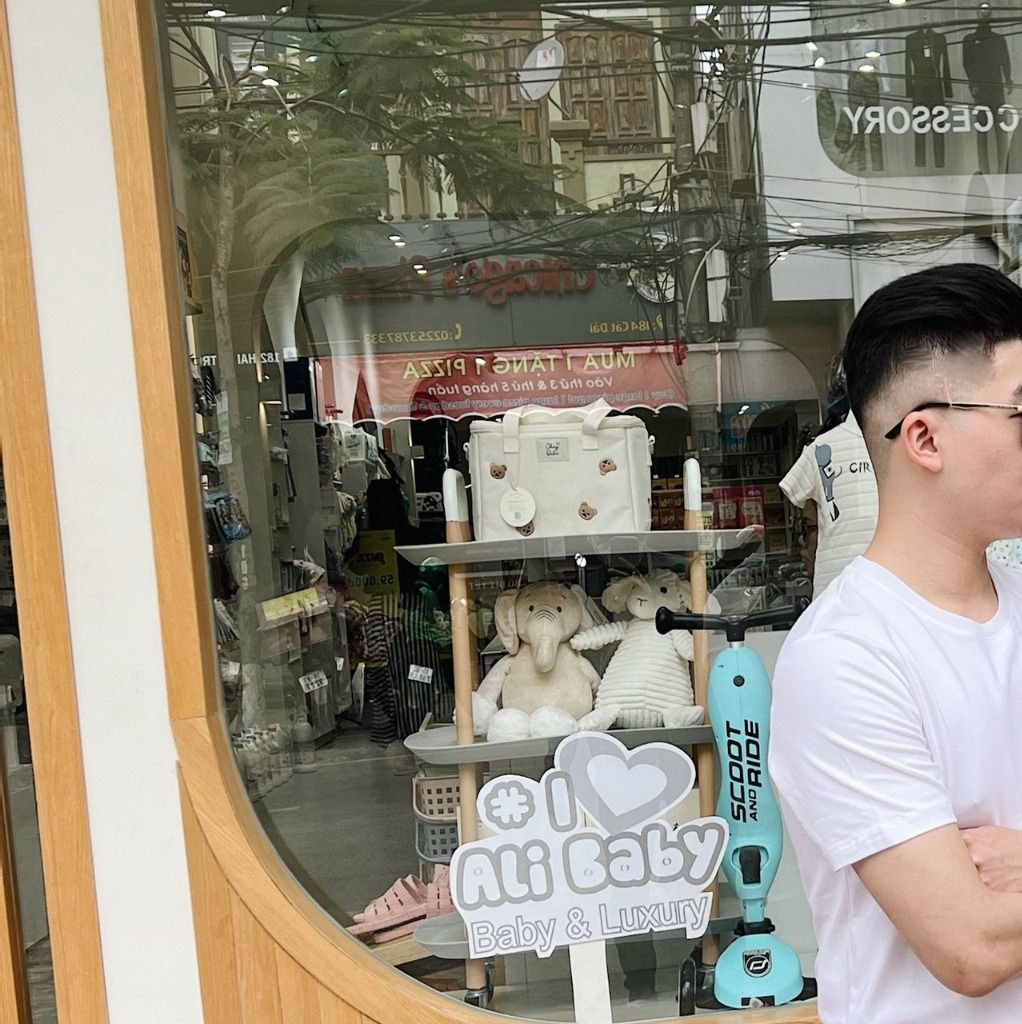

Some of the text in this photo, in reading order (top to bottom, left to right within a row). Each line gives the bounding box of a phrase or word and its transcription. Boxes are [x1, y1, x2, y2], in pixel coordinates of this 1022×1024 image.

[726, 720, 747, 823] SCOOT
[744, 719, 762, 821] AND RIDE
[562, 823, 726, 895] Baby
[470, 896, 708, 954] Baby & Luxury
